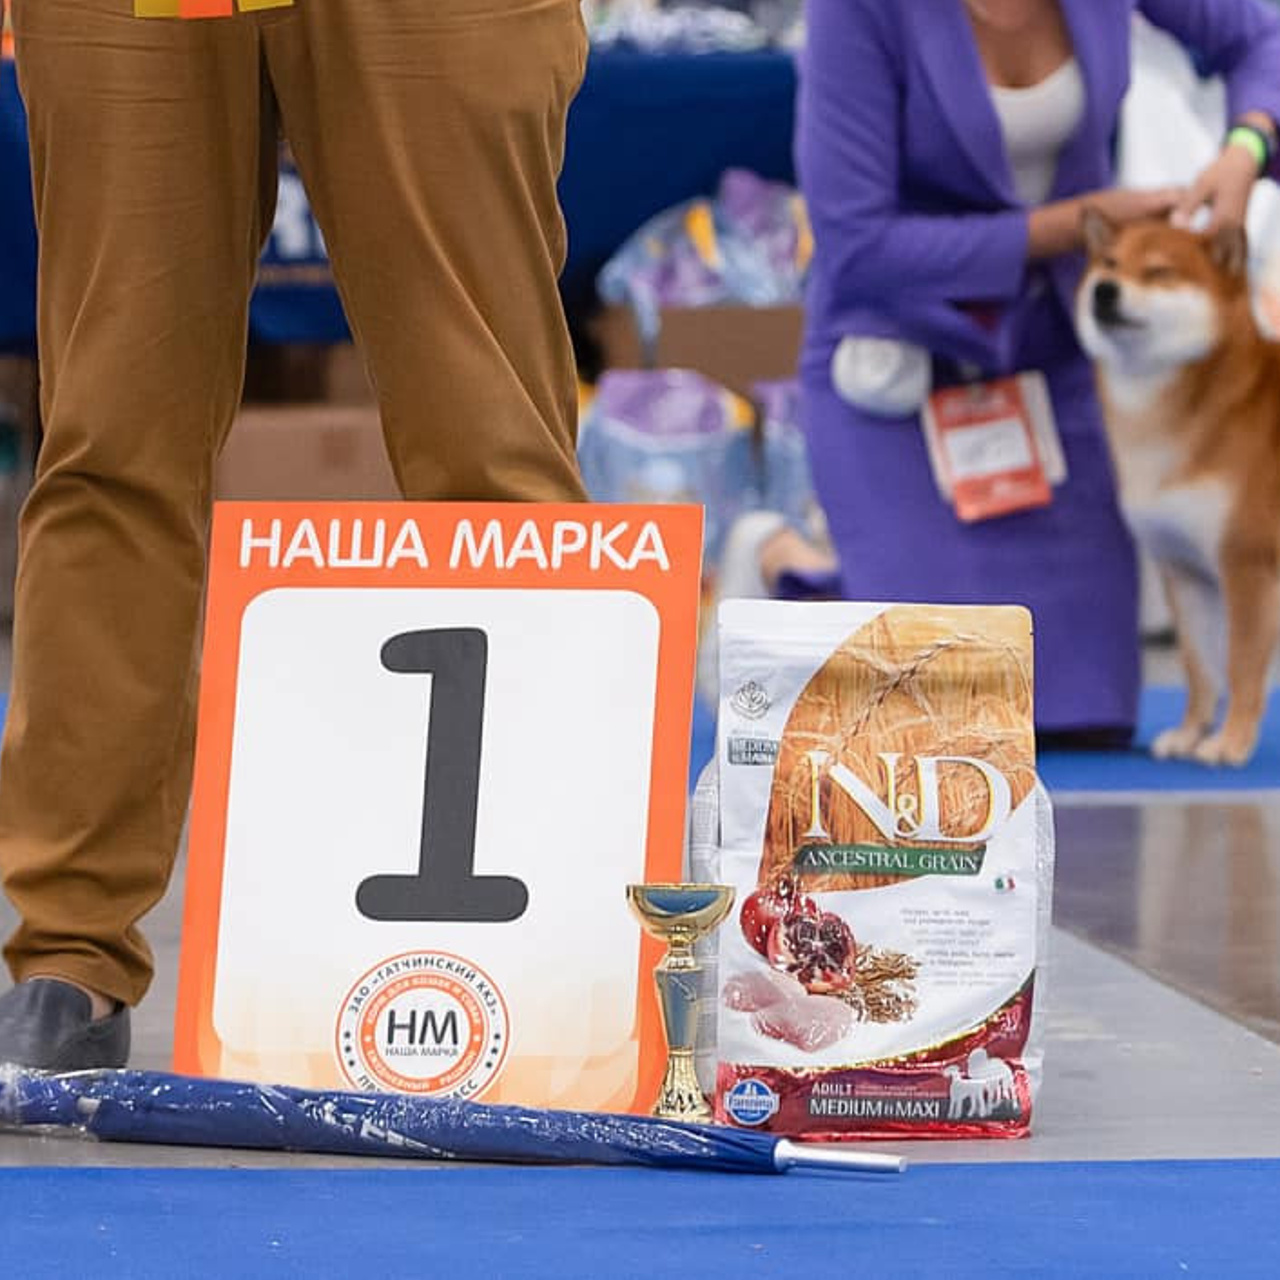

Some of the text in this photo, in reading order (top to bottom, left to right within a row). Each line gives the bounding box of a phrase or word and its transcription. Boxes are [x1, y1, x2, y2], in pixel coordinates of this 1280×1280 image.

[239, 518, 671, 570] НАША МАРКА
[355, 626, 529, 923] 1
[799, 749, 1014, 844] N&D
[803, 849, 978, 871] ANCESTRAL GRAIN
[349, 985, 370, 1014] ЗАО
[387, 1008, 459, 1046] НМ
[385, 1046, 459, 1058] НАША МАРКА
[811, 1081, 853, 1096] ADULT
[809, 1098, 882, 1116] MEDIUM
[895, 1100, 940, 1118] MAXI
